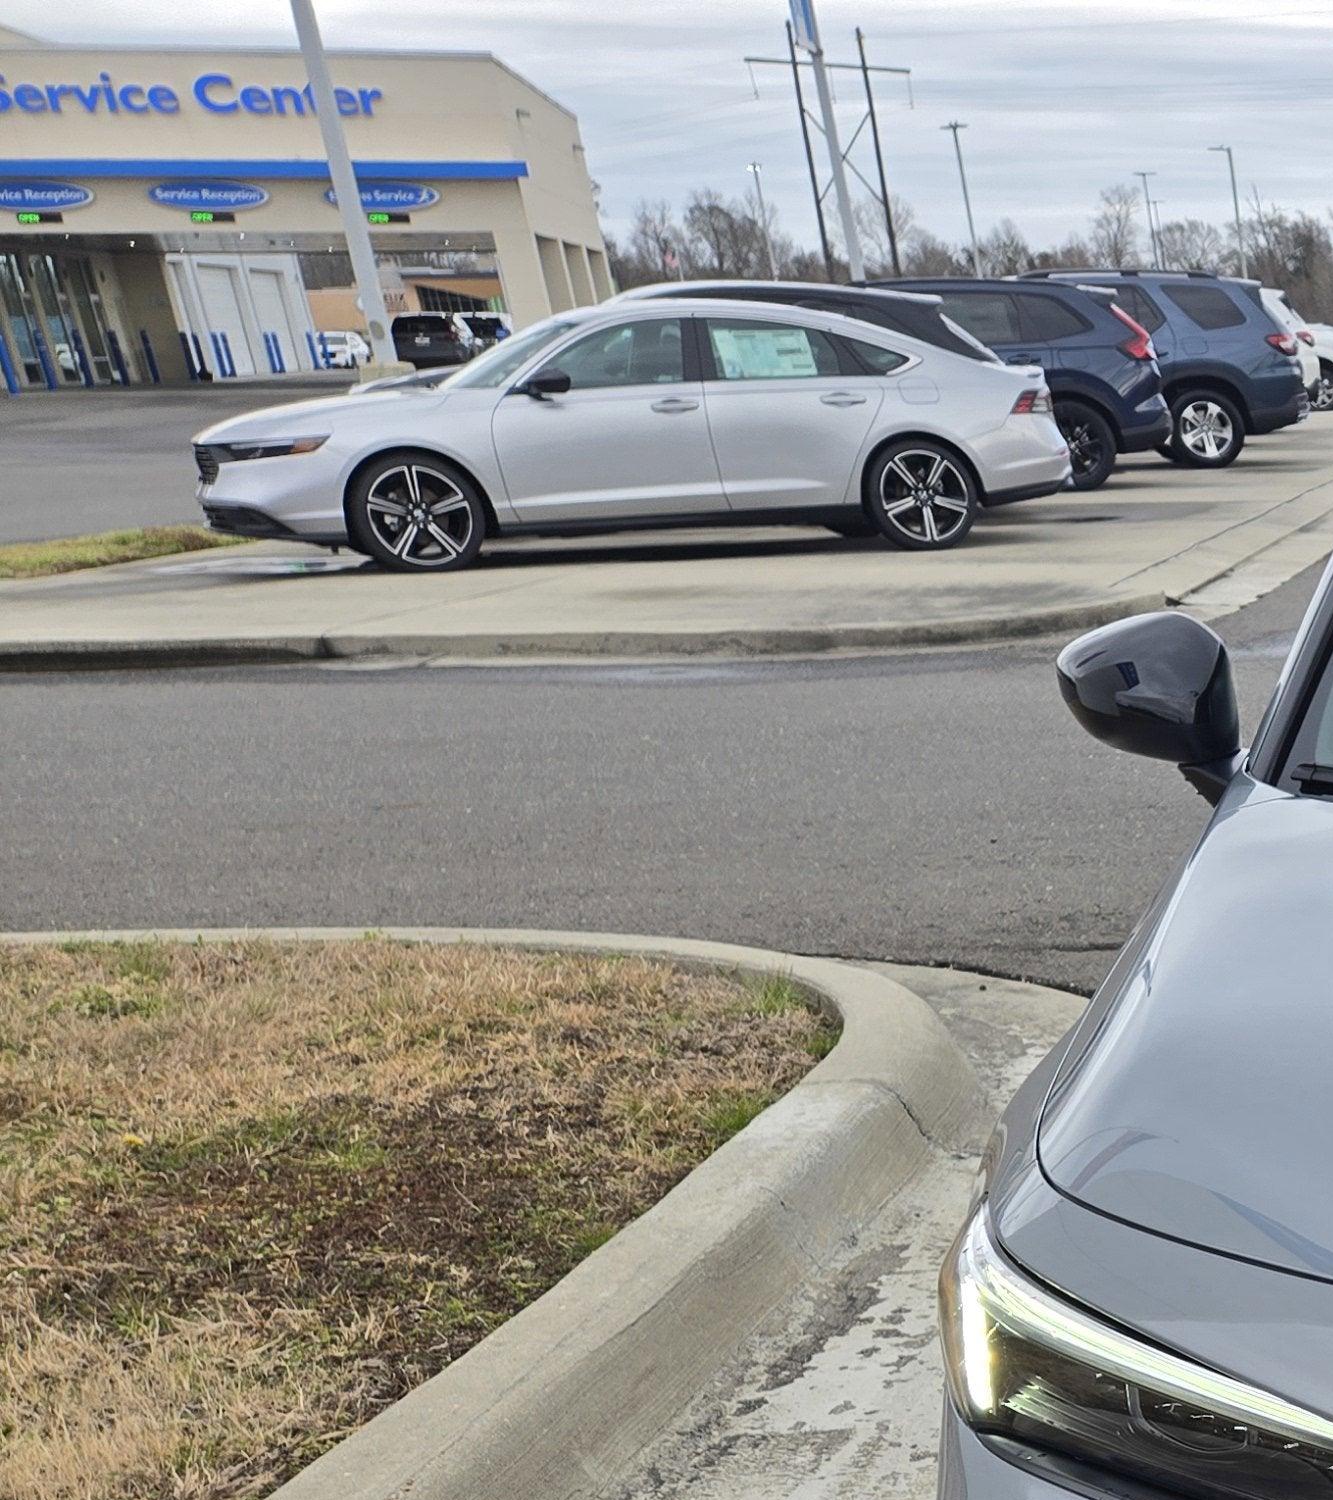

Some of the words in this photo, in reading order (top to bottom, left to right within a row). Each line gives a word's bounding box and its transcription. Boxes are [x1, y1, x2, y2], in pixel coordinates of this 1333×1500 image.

[24, 188, 84, 202] Reception
[155, 188, 199, 200] Service
[201, 188, 260, 202] Reception
